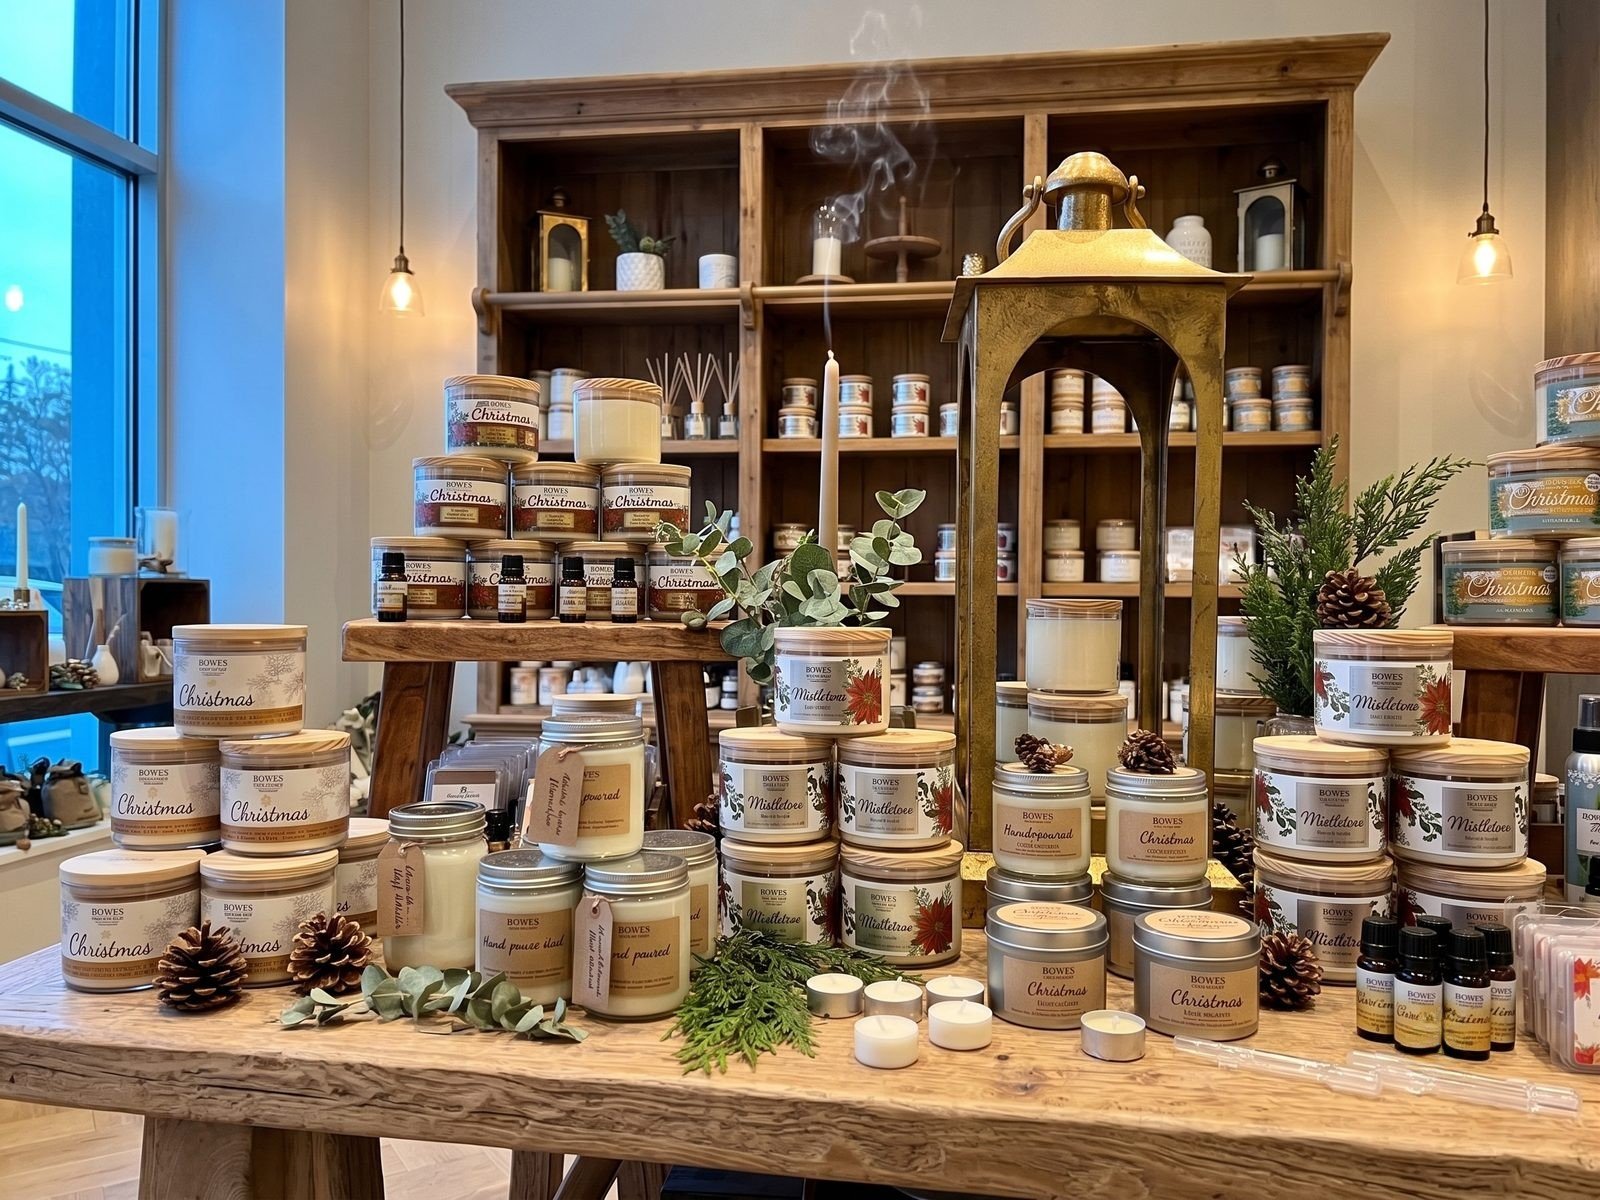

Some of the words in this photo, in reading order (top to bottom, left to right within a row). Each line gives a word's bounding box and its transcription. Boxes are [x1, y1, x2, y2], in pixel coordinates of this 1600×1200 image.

[471, 408, 531, 424] Christmas
[430, 488, 492, 503] Christmas
[1509, 484, 1596, 510] Christmas
[527, 494, 587, 508] Christmas
[615, 494, 674, 508] Christmas
[406, 574, 452, 583] ristmas
[1467, 575, 1552, 598] Christmas
[198, 659, 228, 667] BOWES
[805, 666, 832, 674] BOWES
[179, 683, 255, 707] Christmas
[138, 769, 169, 777] BOWES
[253, 774, 284, 783] BOWES
[872, 778, 900, 786] BOWES
[1319, 789, 1350, 797] BOWES
[1466, 794, 1498, 802] BOWES
[117, 793, 195, 816] Christmas
[230, 800, 310, 823] Christmas
[1022, 811, 1054, 820] BOWES
[1152, 817, 1184, 825] BOWES
[1139, 830, 1195, 845] Christmas
[91, 908, 124, 916] BOWES
[223, 903, 253, 912] BOWES
[1322, 908, 1354, 917] BOWES
[1466, 912, 1499, 921] BOWES
[507, 918, 540, 926] BOWES
[617, 925, 651, 934] BOWES
[69, 932, 154, 958] Christmas
[483, 935, 507, 950] Hand
[1042, 966, 1075, 975] BOWES
[1190, 975, 1226, 985] BOWES
[1366, 977, 1394, 987] BOWES
[1027, 981, 1088, 997] Christmas
[1490, 987, 1513, 995] OWES
[1171, 988, 1243, 1009] Christmas
[1407, 990, 1437, 1000] BOWES
[1455, 992, 1484, 1002] BOWES
